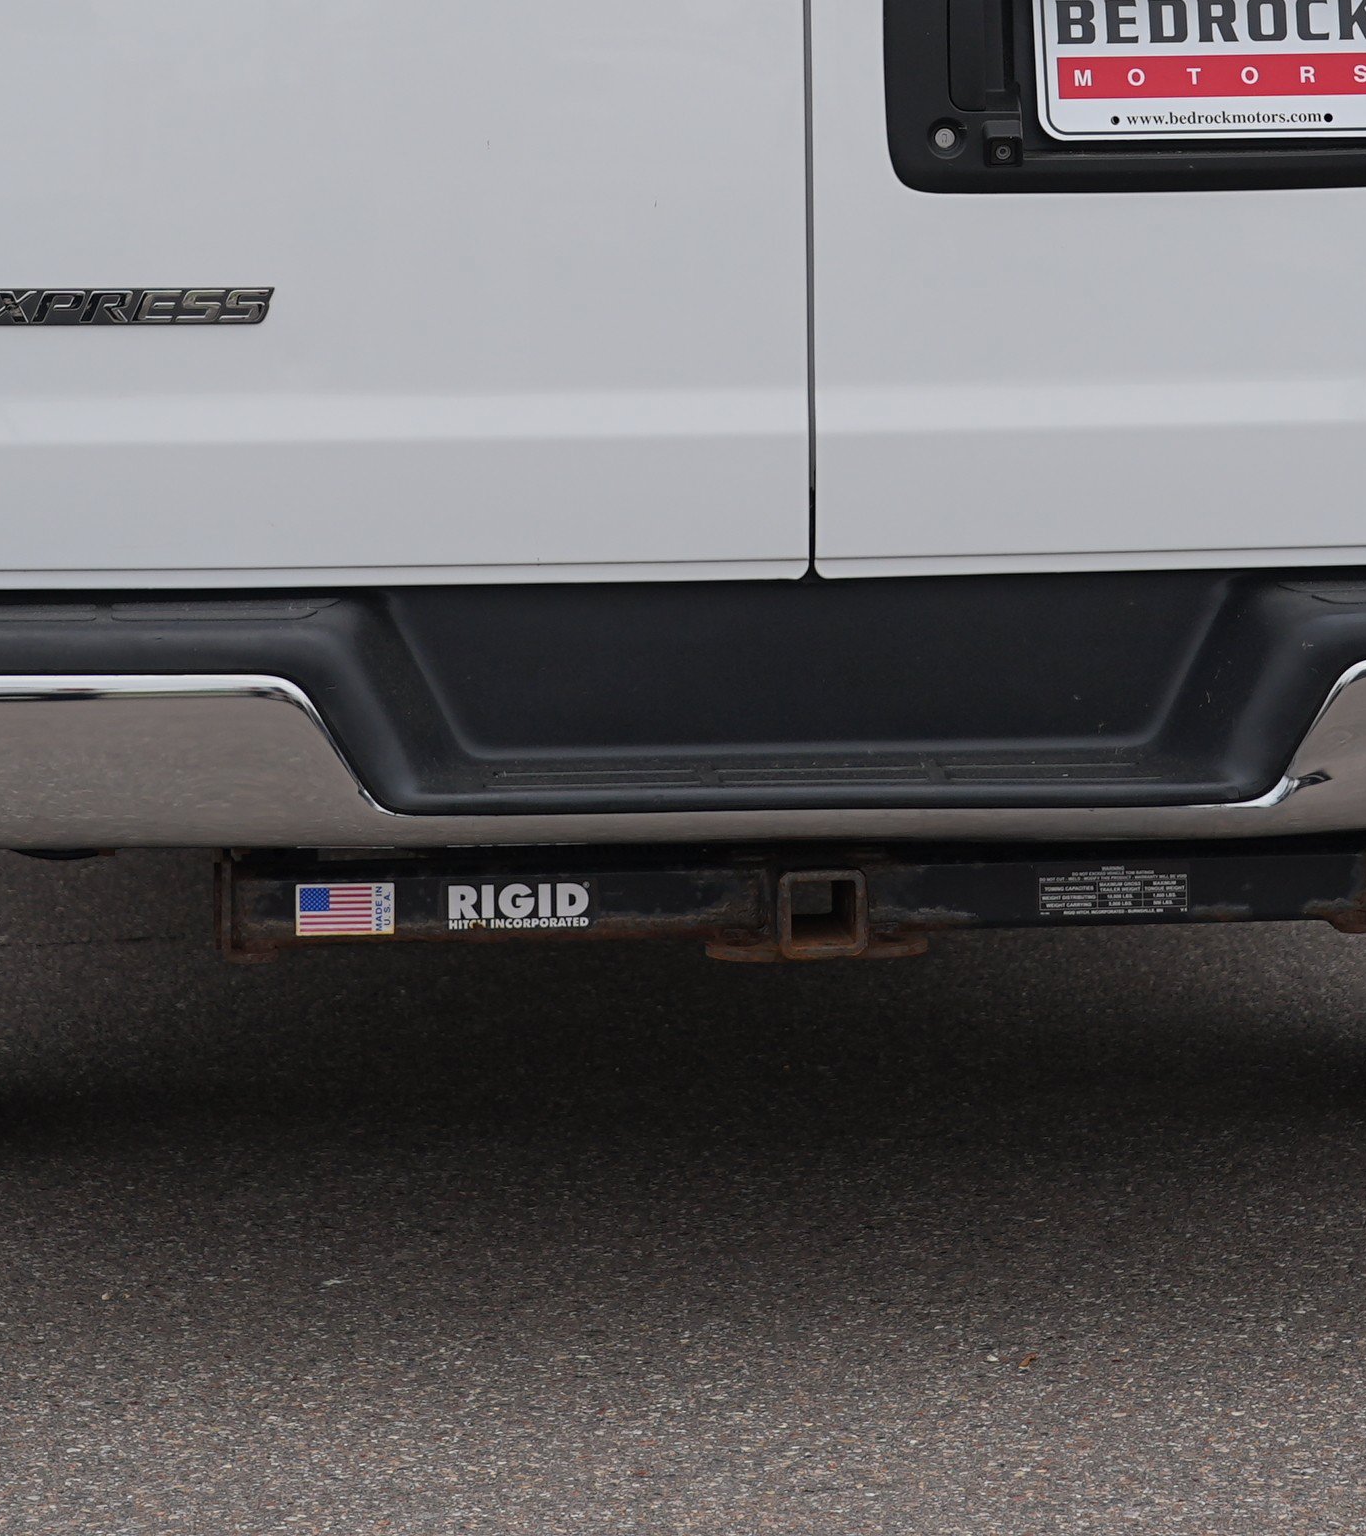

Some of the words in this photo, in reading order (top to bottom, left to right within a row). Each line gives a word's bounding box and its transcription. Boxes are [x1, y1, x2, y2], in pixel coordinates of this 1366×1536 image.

[1126, 108, 1322, 125] www.bedrockmotors.com
[376, 886, 382, 896] IN
[448, 882, 590, 919] RIGID
[491, 917, 589, 929] INCORPORATED
